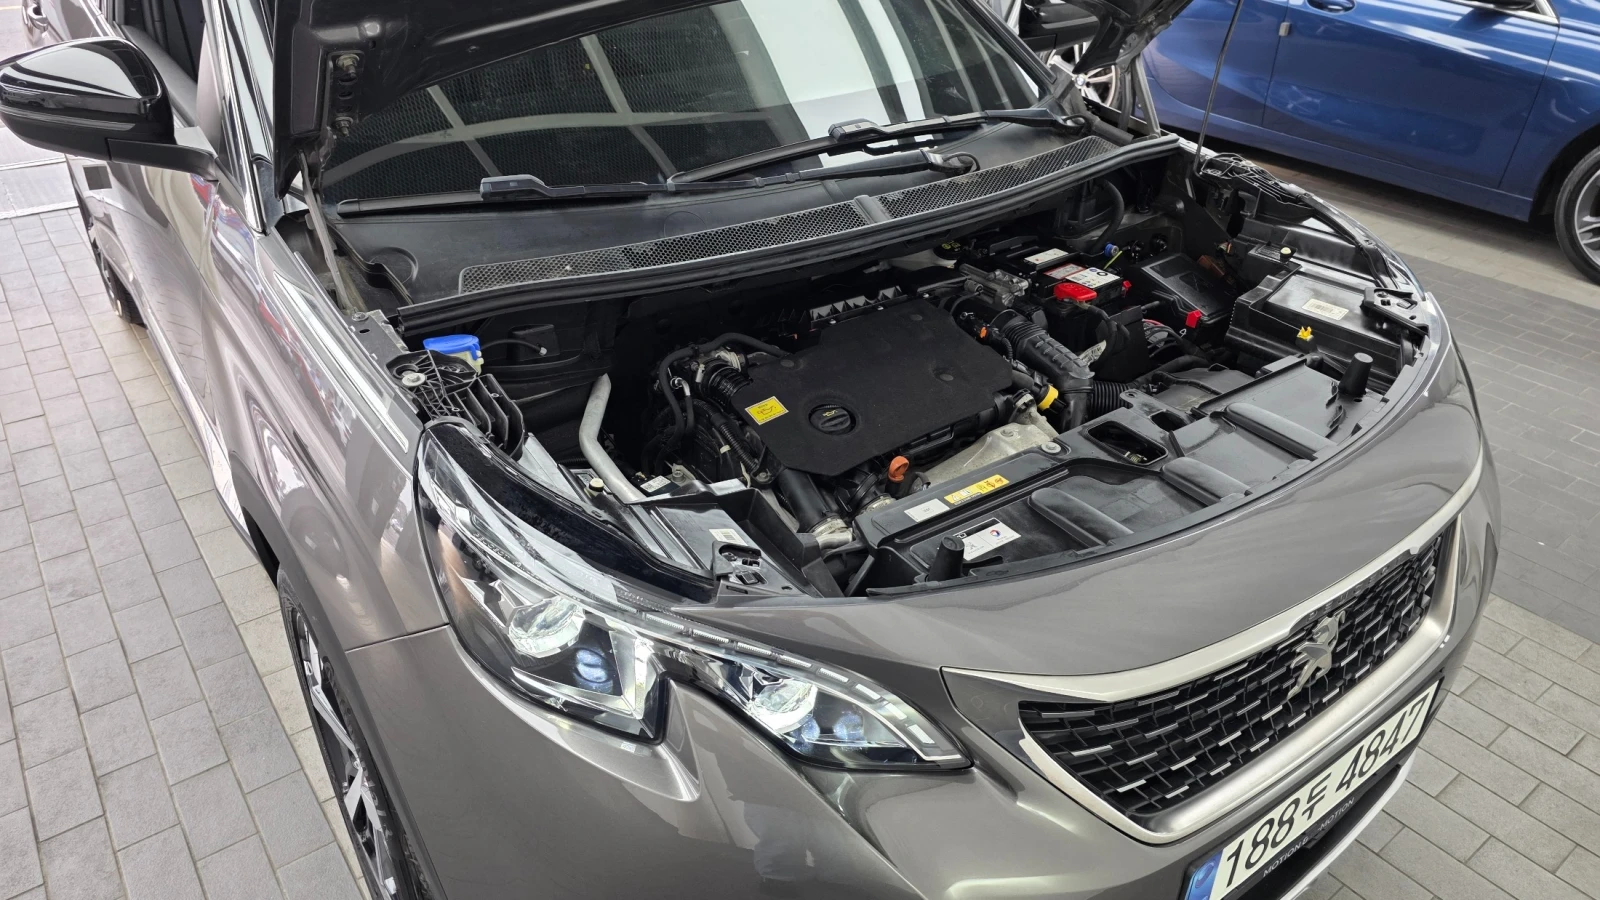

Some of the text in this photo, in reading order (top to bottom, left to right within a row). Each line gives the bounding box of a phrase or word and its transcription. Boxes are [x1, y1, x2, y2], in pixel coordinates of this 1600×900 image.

[1225, 691, 1430, 888] 188두 4847
[1262, 842, 1302, 878] MOTION
